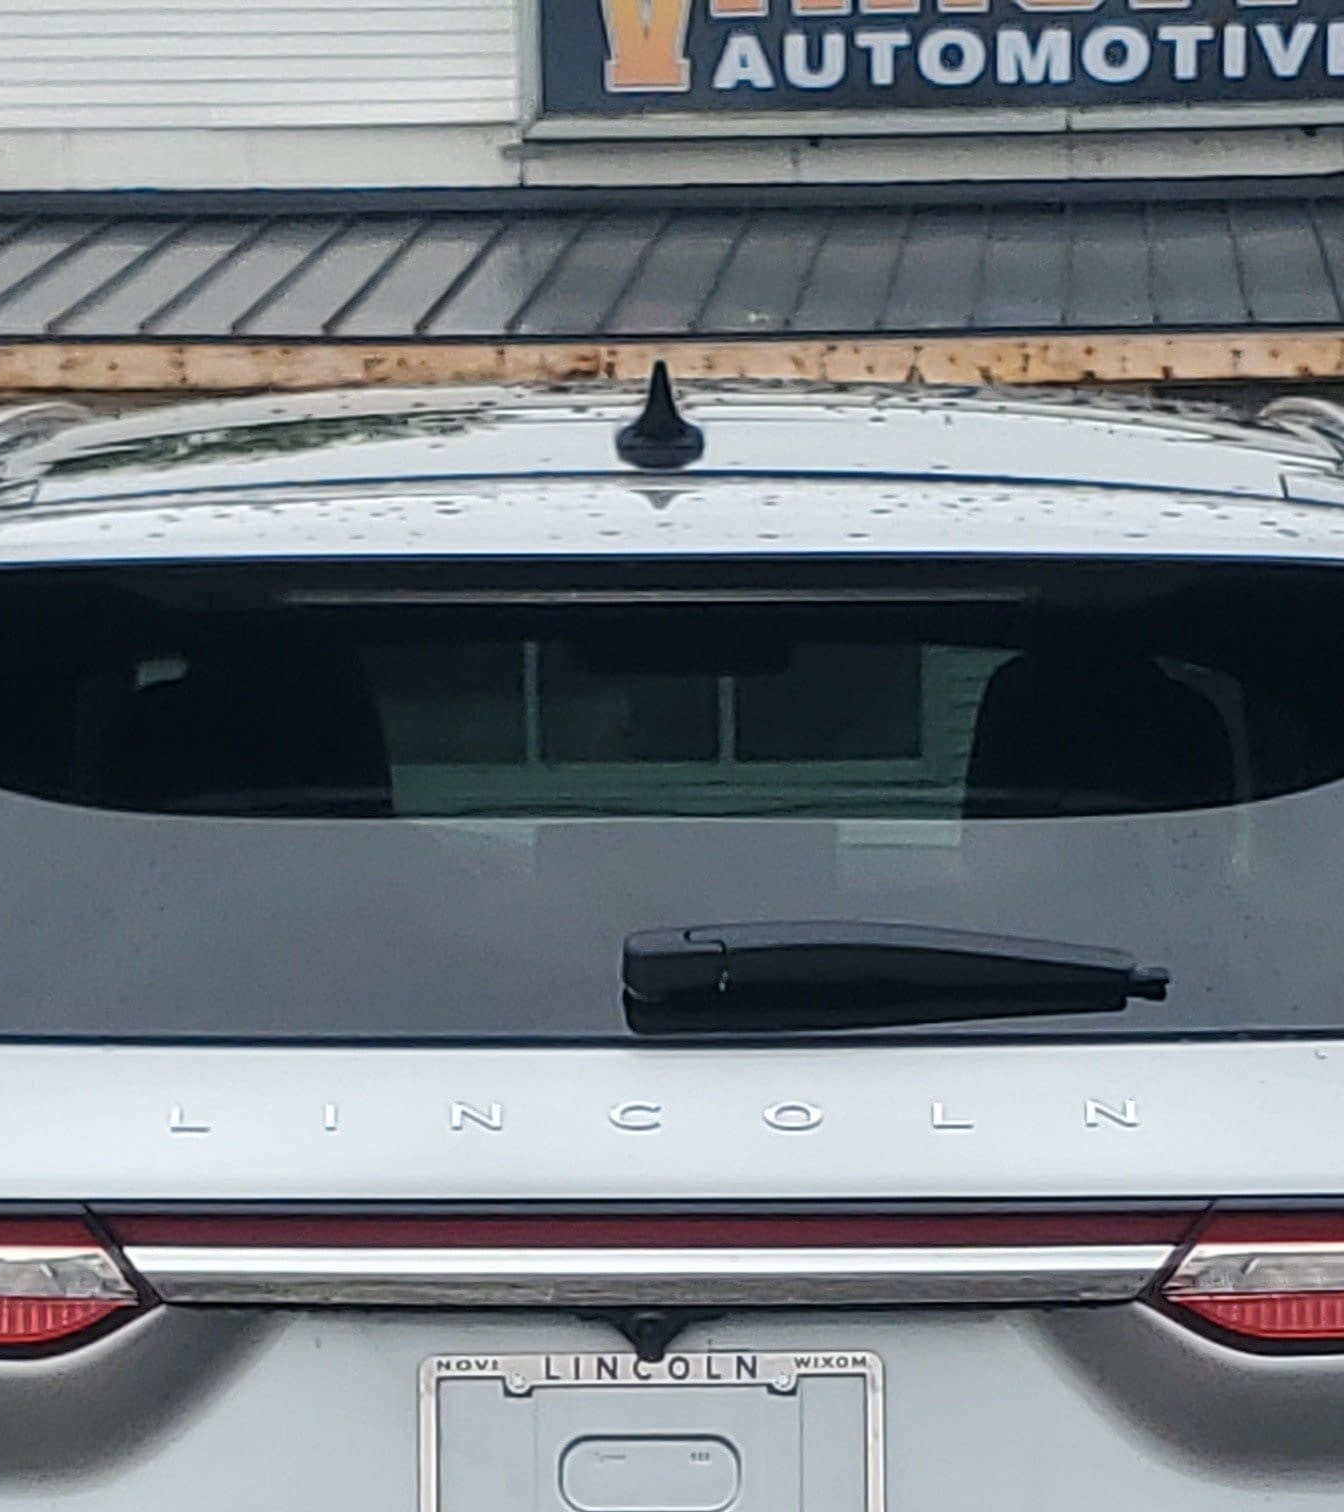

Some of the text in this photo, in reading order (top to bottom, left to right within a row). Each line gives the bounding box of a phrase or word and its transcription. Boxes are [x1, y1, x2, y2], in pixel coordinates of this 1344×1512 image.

[168, 1097, 1141, 1133] LINCOLN
[435, 1355, 868, 1381] NOVI LINCOLN WIXOM
